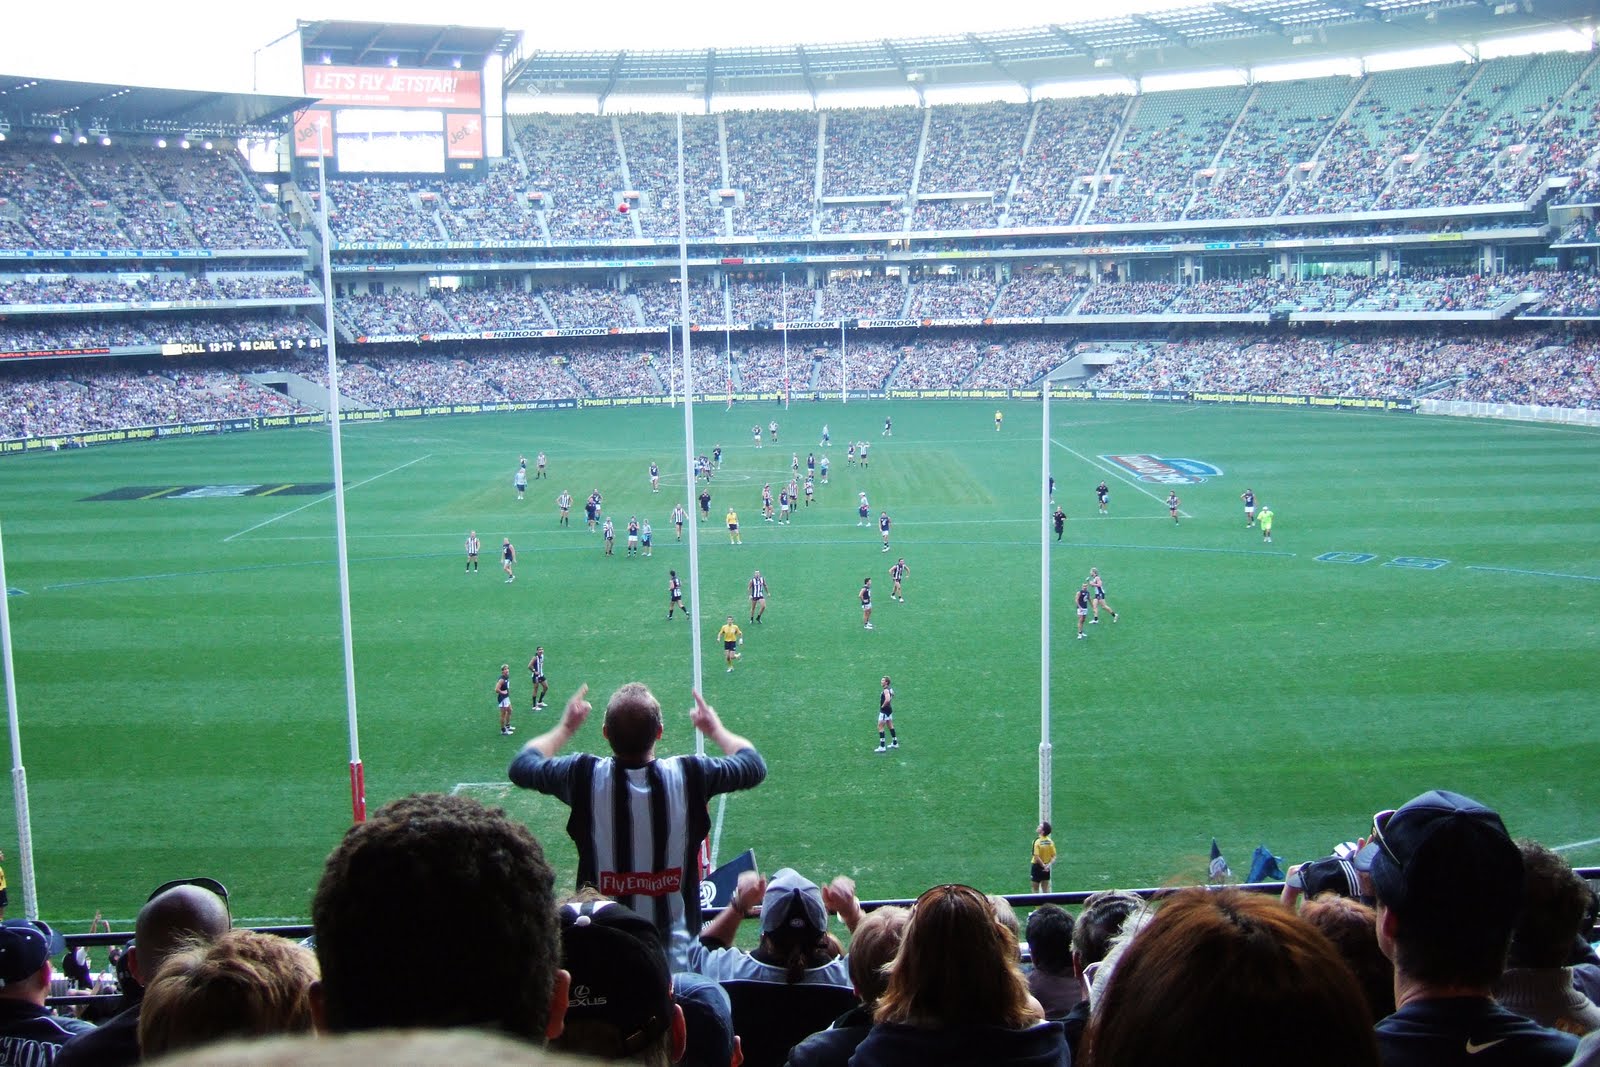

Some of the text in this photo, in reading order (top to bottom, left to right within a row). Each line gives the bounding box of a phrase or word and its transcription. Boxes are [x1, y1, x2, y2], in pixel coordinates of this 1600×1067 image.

[314, 72, 459, 94] LET'S FLY JETSTAR!
[450, 126, 470, 145] Jet
[338, 242, 403, 250] PACK SEND
[409, 241, 434, 249] PACK
[479, 240, 544, 248] PACK SEND
[181, 344, 205, 354] COLL
[253, 340, 277, 350] CARL
[310, 338, 321, 348] 81
[584, 398, 610, 407] Protect
[612, 396, 641, 406] yourself
[395, 407, 421, 417] Demand
[424, 405, 451, 415] curtain
[263, 417, 289, 426] Protect
[603, 874, 680, 893] Fly Emirates
[568, 997, 607, 1007] EXUS
